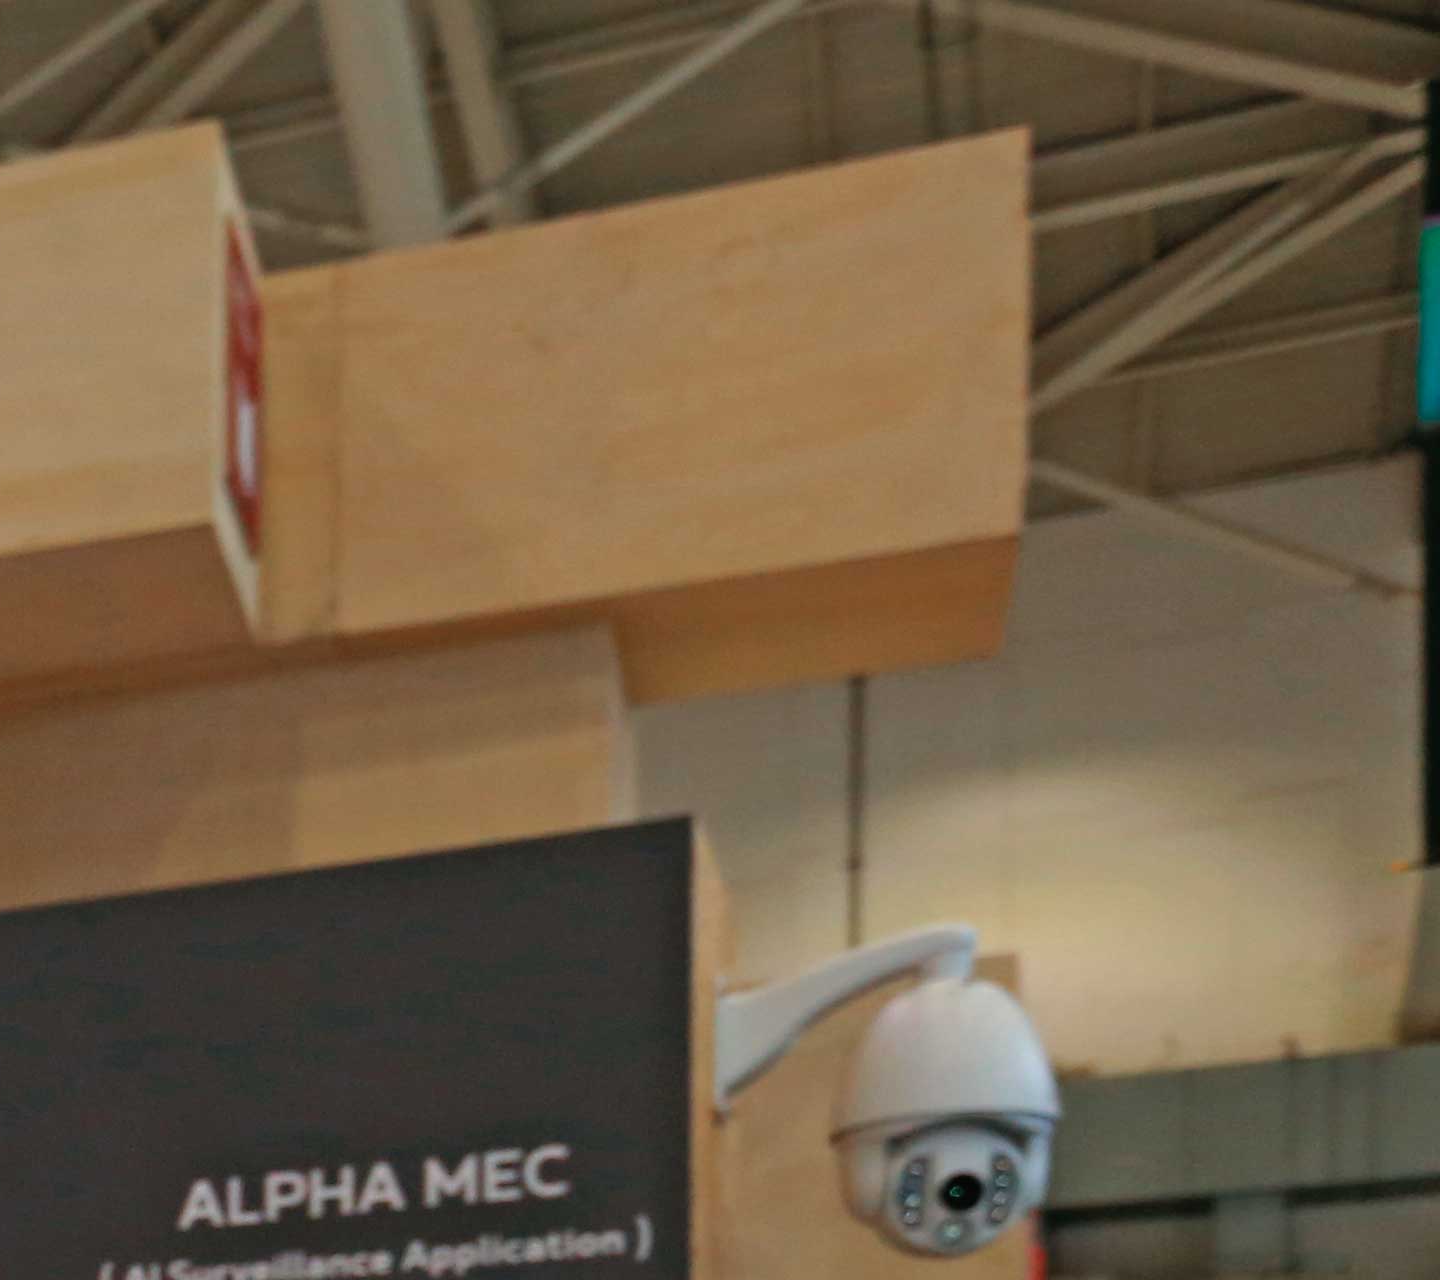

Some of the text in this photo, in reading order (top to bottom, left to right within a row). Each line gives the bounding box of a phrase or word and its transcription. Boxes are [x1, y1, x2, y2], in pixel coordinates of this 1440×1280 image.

[177, 1143, 573, 1232] ALPHA MEC
[400, 1229, 627, 1277] Application
